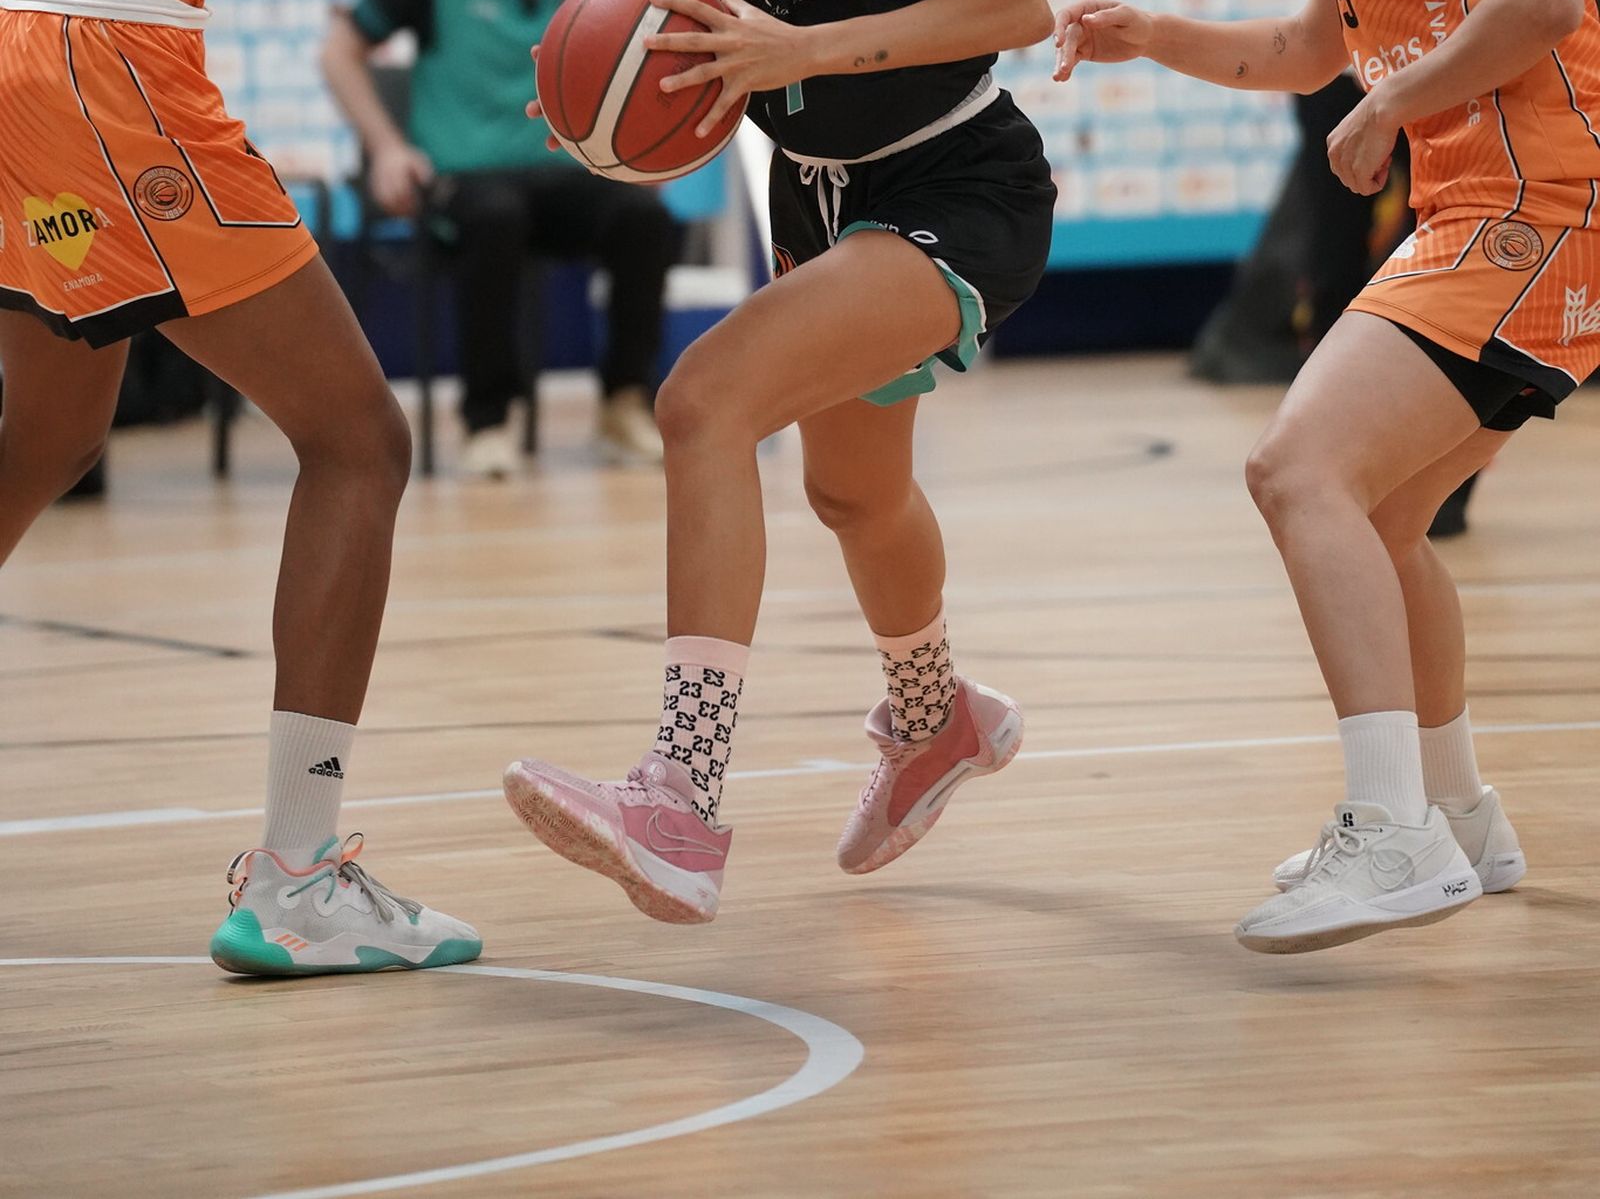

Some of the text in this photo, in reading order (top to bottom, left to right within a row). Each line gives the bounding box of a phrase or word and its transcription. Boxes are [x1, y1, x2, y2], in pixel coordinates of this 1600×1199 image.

[22, 207, 115, 248] ZAMORA
[63, 272, 104, 291] ENAMORA
[679, 681, 702, 699] 23
[906, 718, 928, 732] 23
[692, 735, 714, 756] 23
[308, 767, 344, 780] adidas
